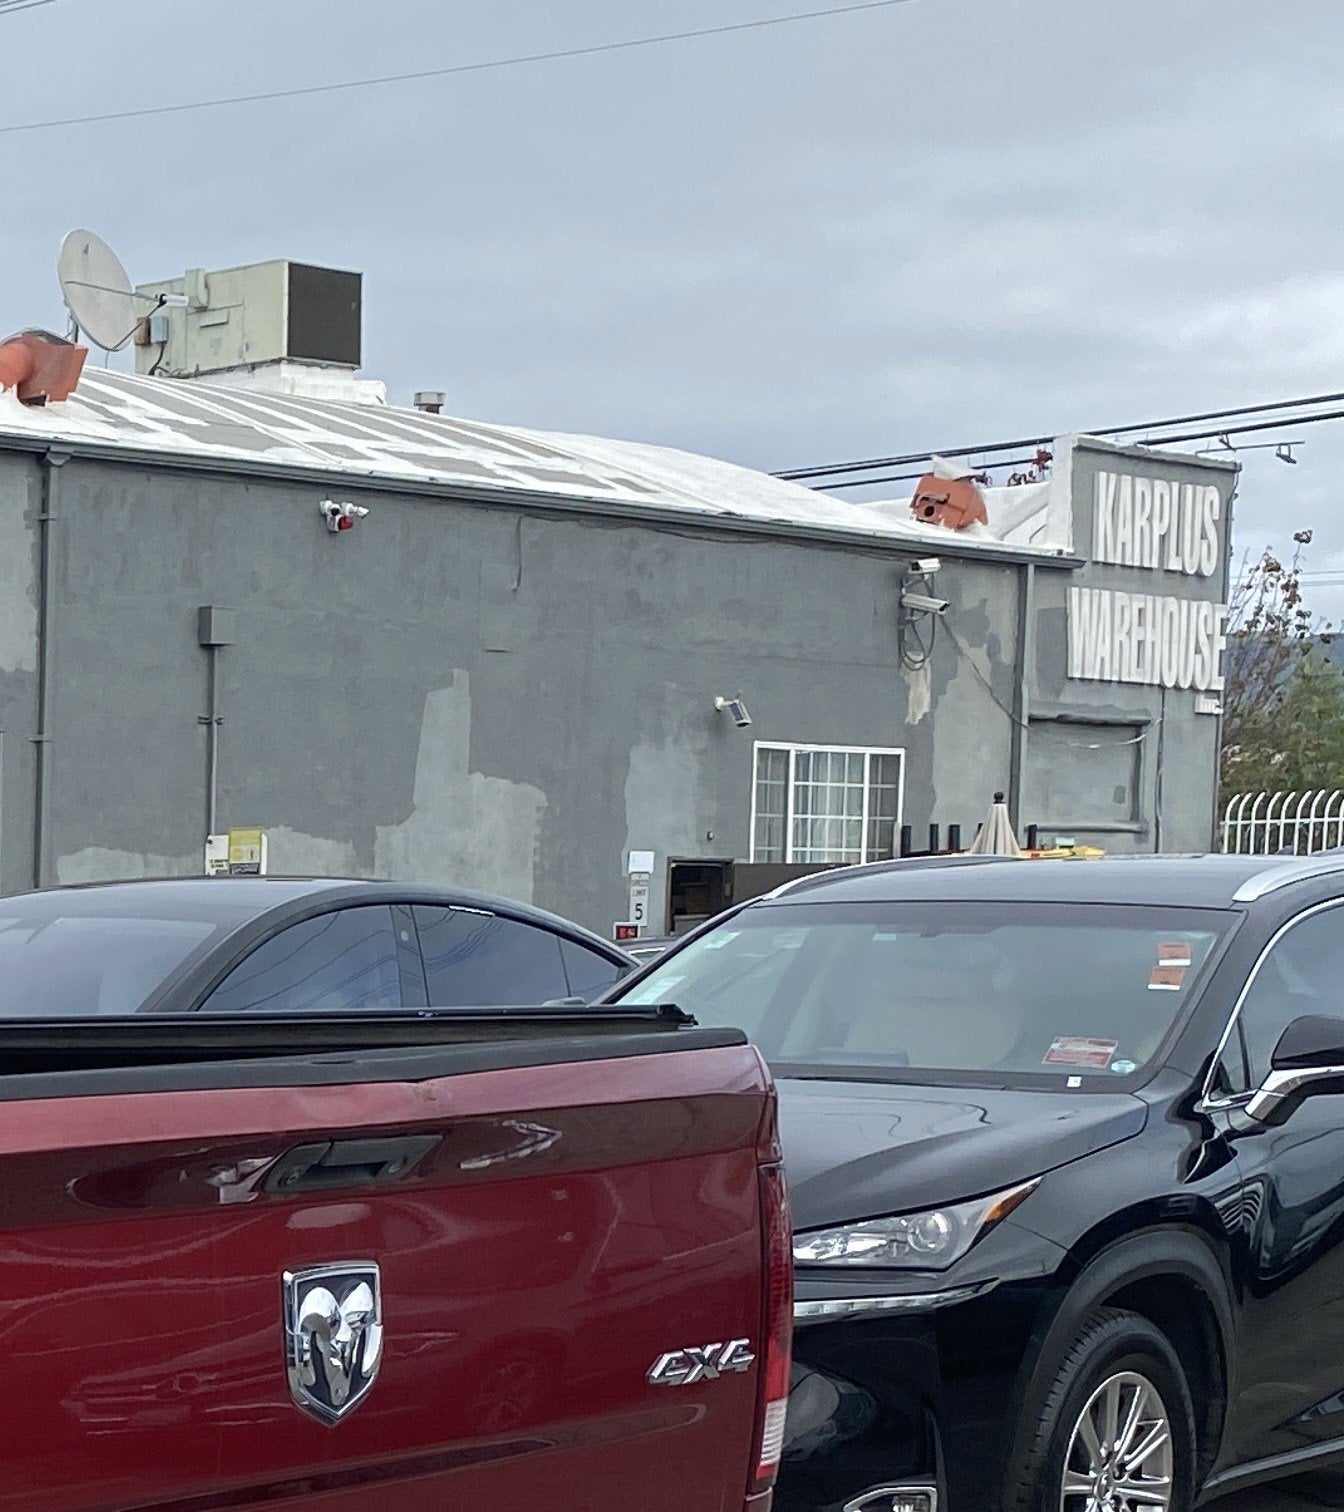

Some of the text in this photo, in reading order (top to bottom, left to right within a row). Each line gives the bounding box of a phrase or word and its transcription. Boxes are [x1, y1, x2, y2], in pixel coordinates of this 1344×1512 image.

[1092, 470, 1221, 577] KARPLUS
[1066, 586, 1228, 691] WAREHOUSE
[635, 902, 643, 921] 5
